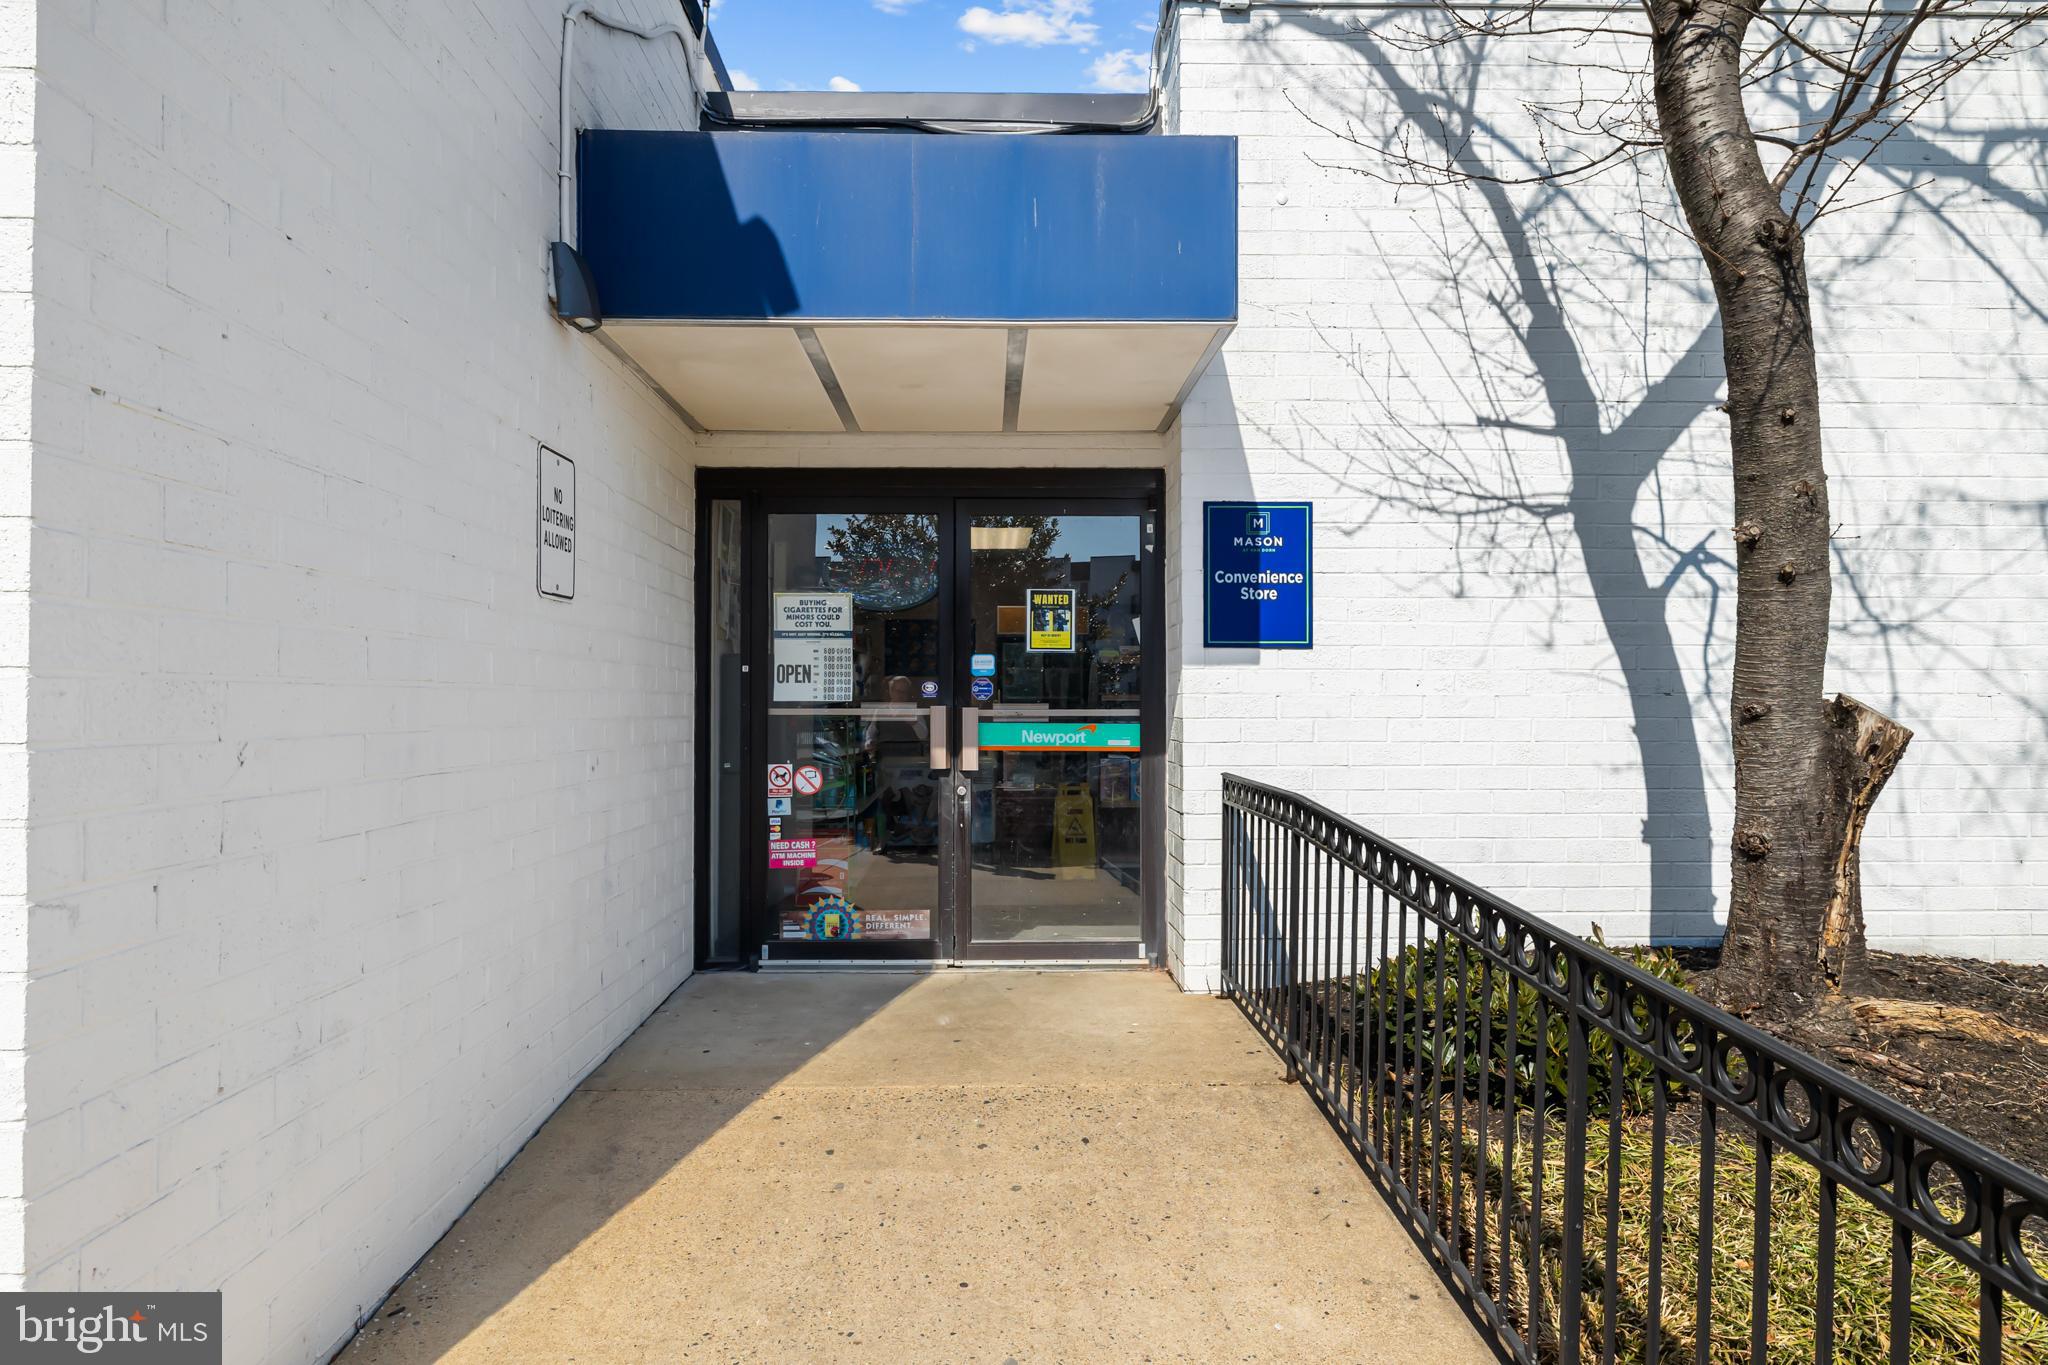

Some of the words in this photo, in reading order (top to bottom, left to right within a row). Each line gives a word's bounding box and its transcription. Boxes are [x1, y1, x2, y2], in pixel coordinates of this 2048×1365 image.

[554, 487, 563, 504] NO
[542, 505, 573, 531] LOITERING
[543, 530, 572, 552] ALLOWED
[1233, 536, 1283, 547] MASON
[1214, 570, 1304, 584] Convenience
[1033, 594, 1069, 605] WANTED
[1240, 587, 1278, 600] Store
[776, 664, 812, 684] OPEN
[1021, 729, 1087, 746] Newport
[791, 841, 810, 849] CASH
[865, 914, 890, 922] REAL.
[865, 922, 914, 930] DIFFERENT.
